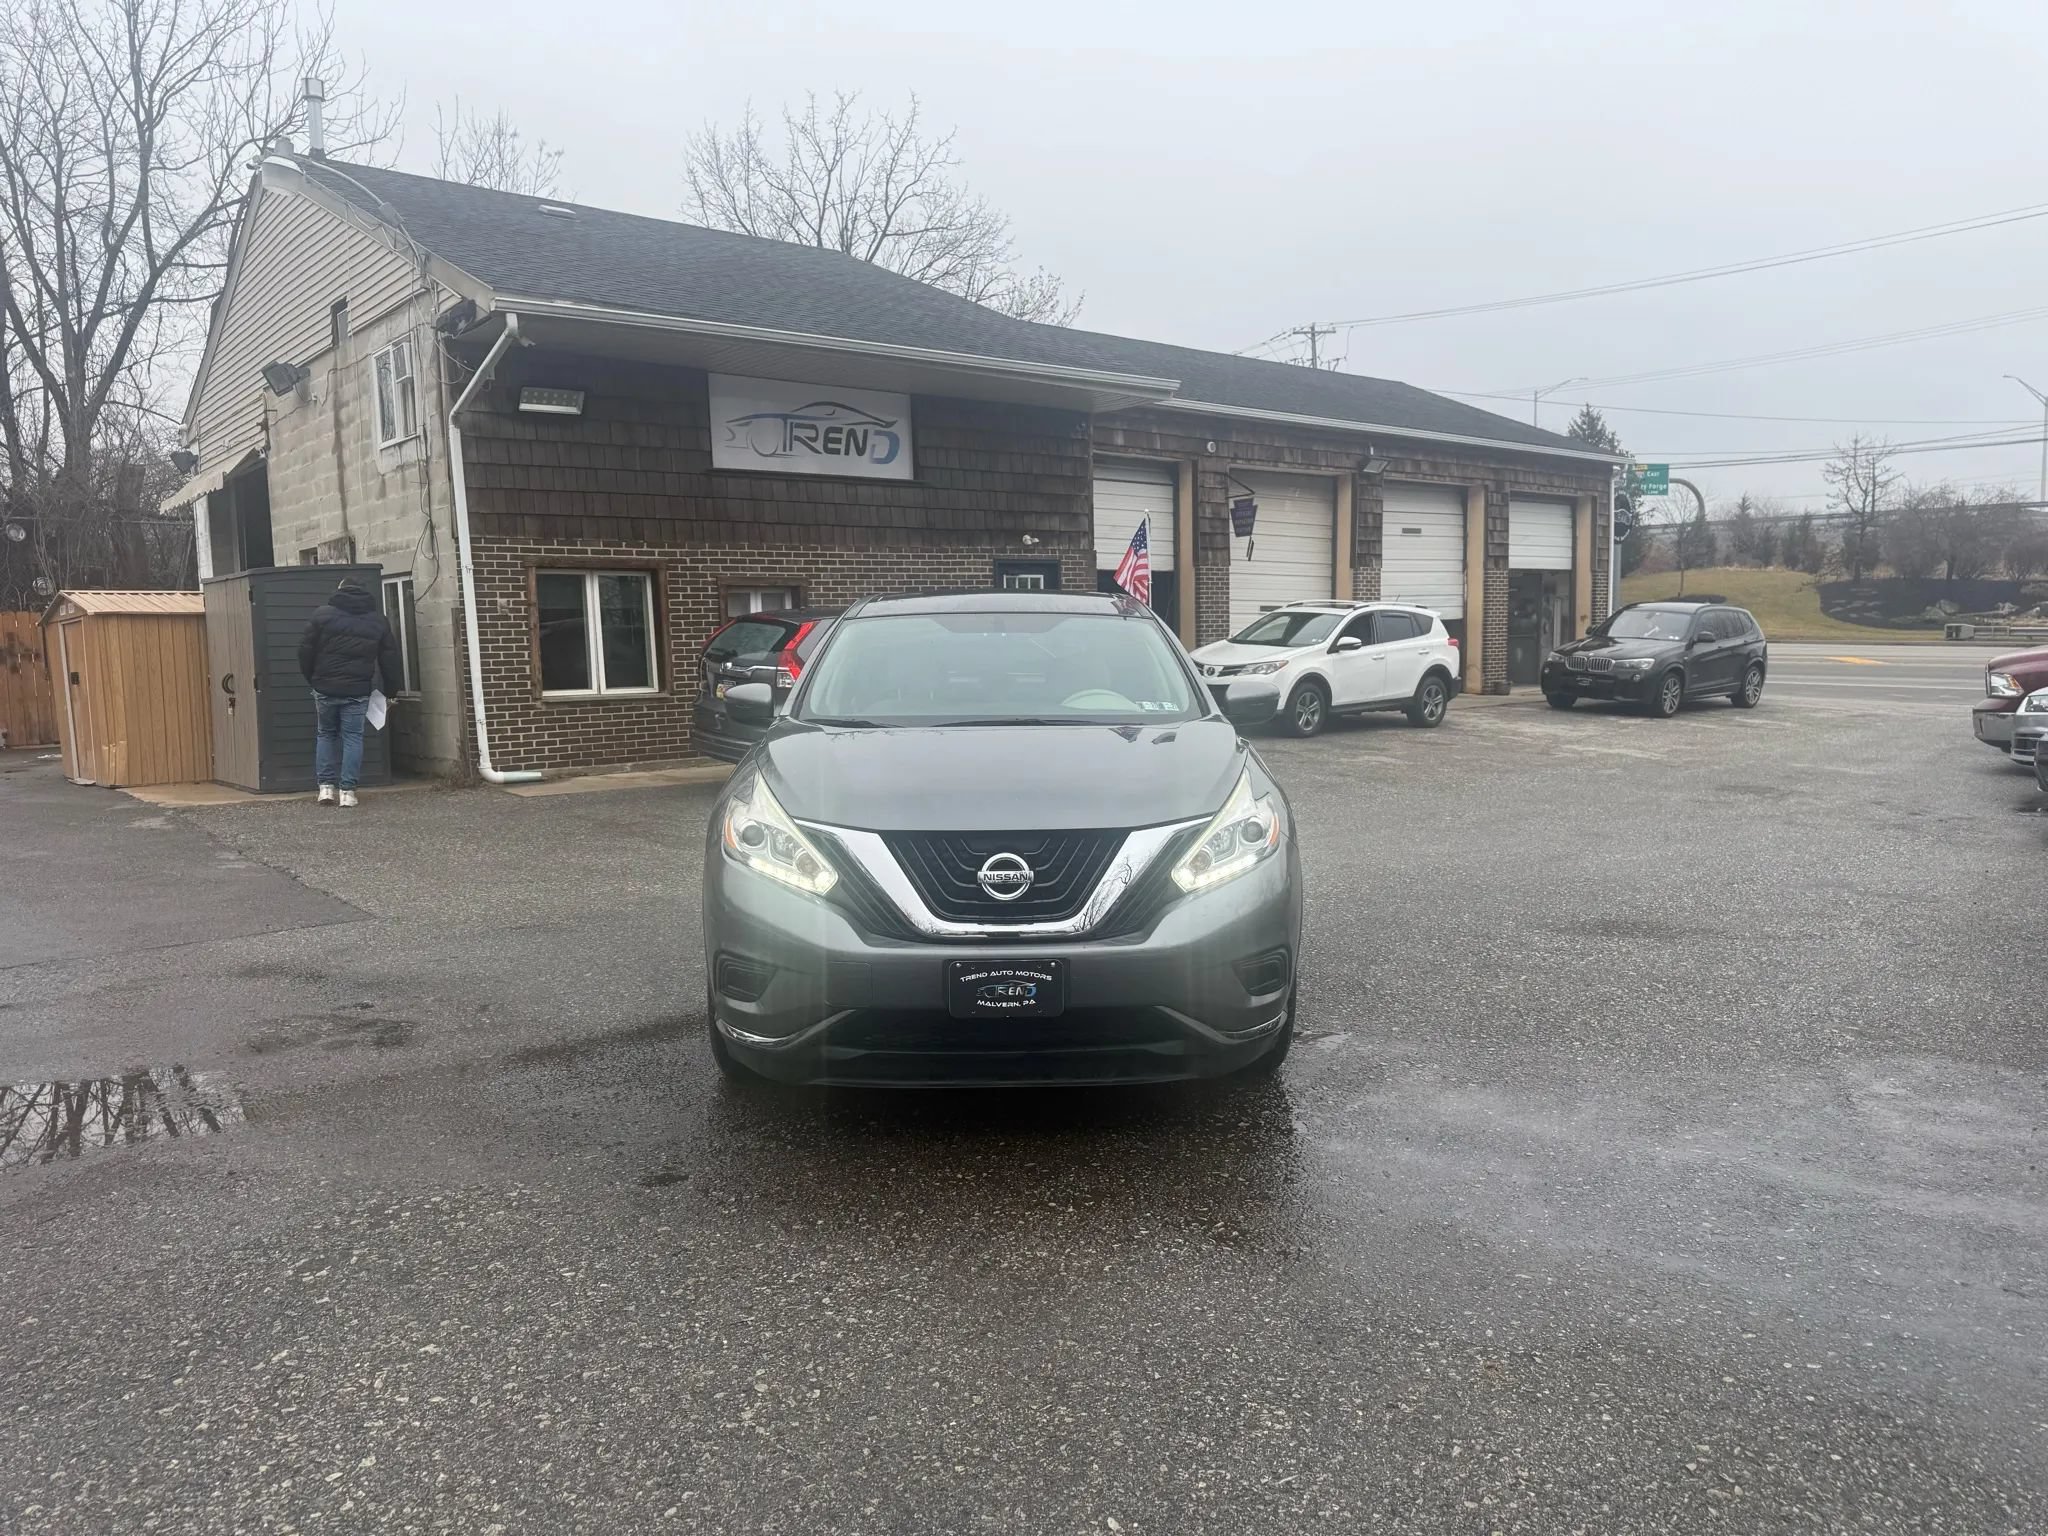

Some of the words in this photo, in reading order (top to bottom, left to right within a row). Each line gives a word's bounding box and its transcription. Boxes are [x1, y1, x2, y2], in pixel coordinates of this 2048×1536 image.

[780, 414, 900, 465] TREND
[983, 873, 1028, 881] NISSAN
[960, 972, 988, 983] TREND
[1015, 970, 1053, 981] MOTORS
